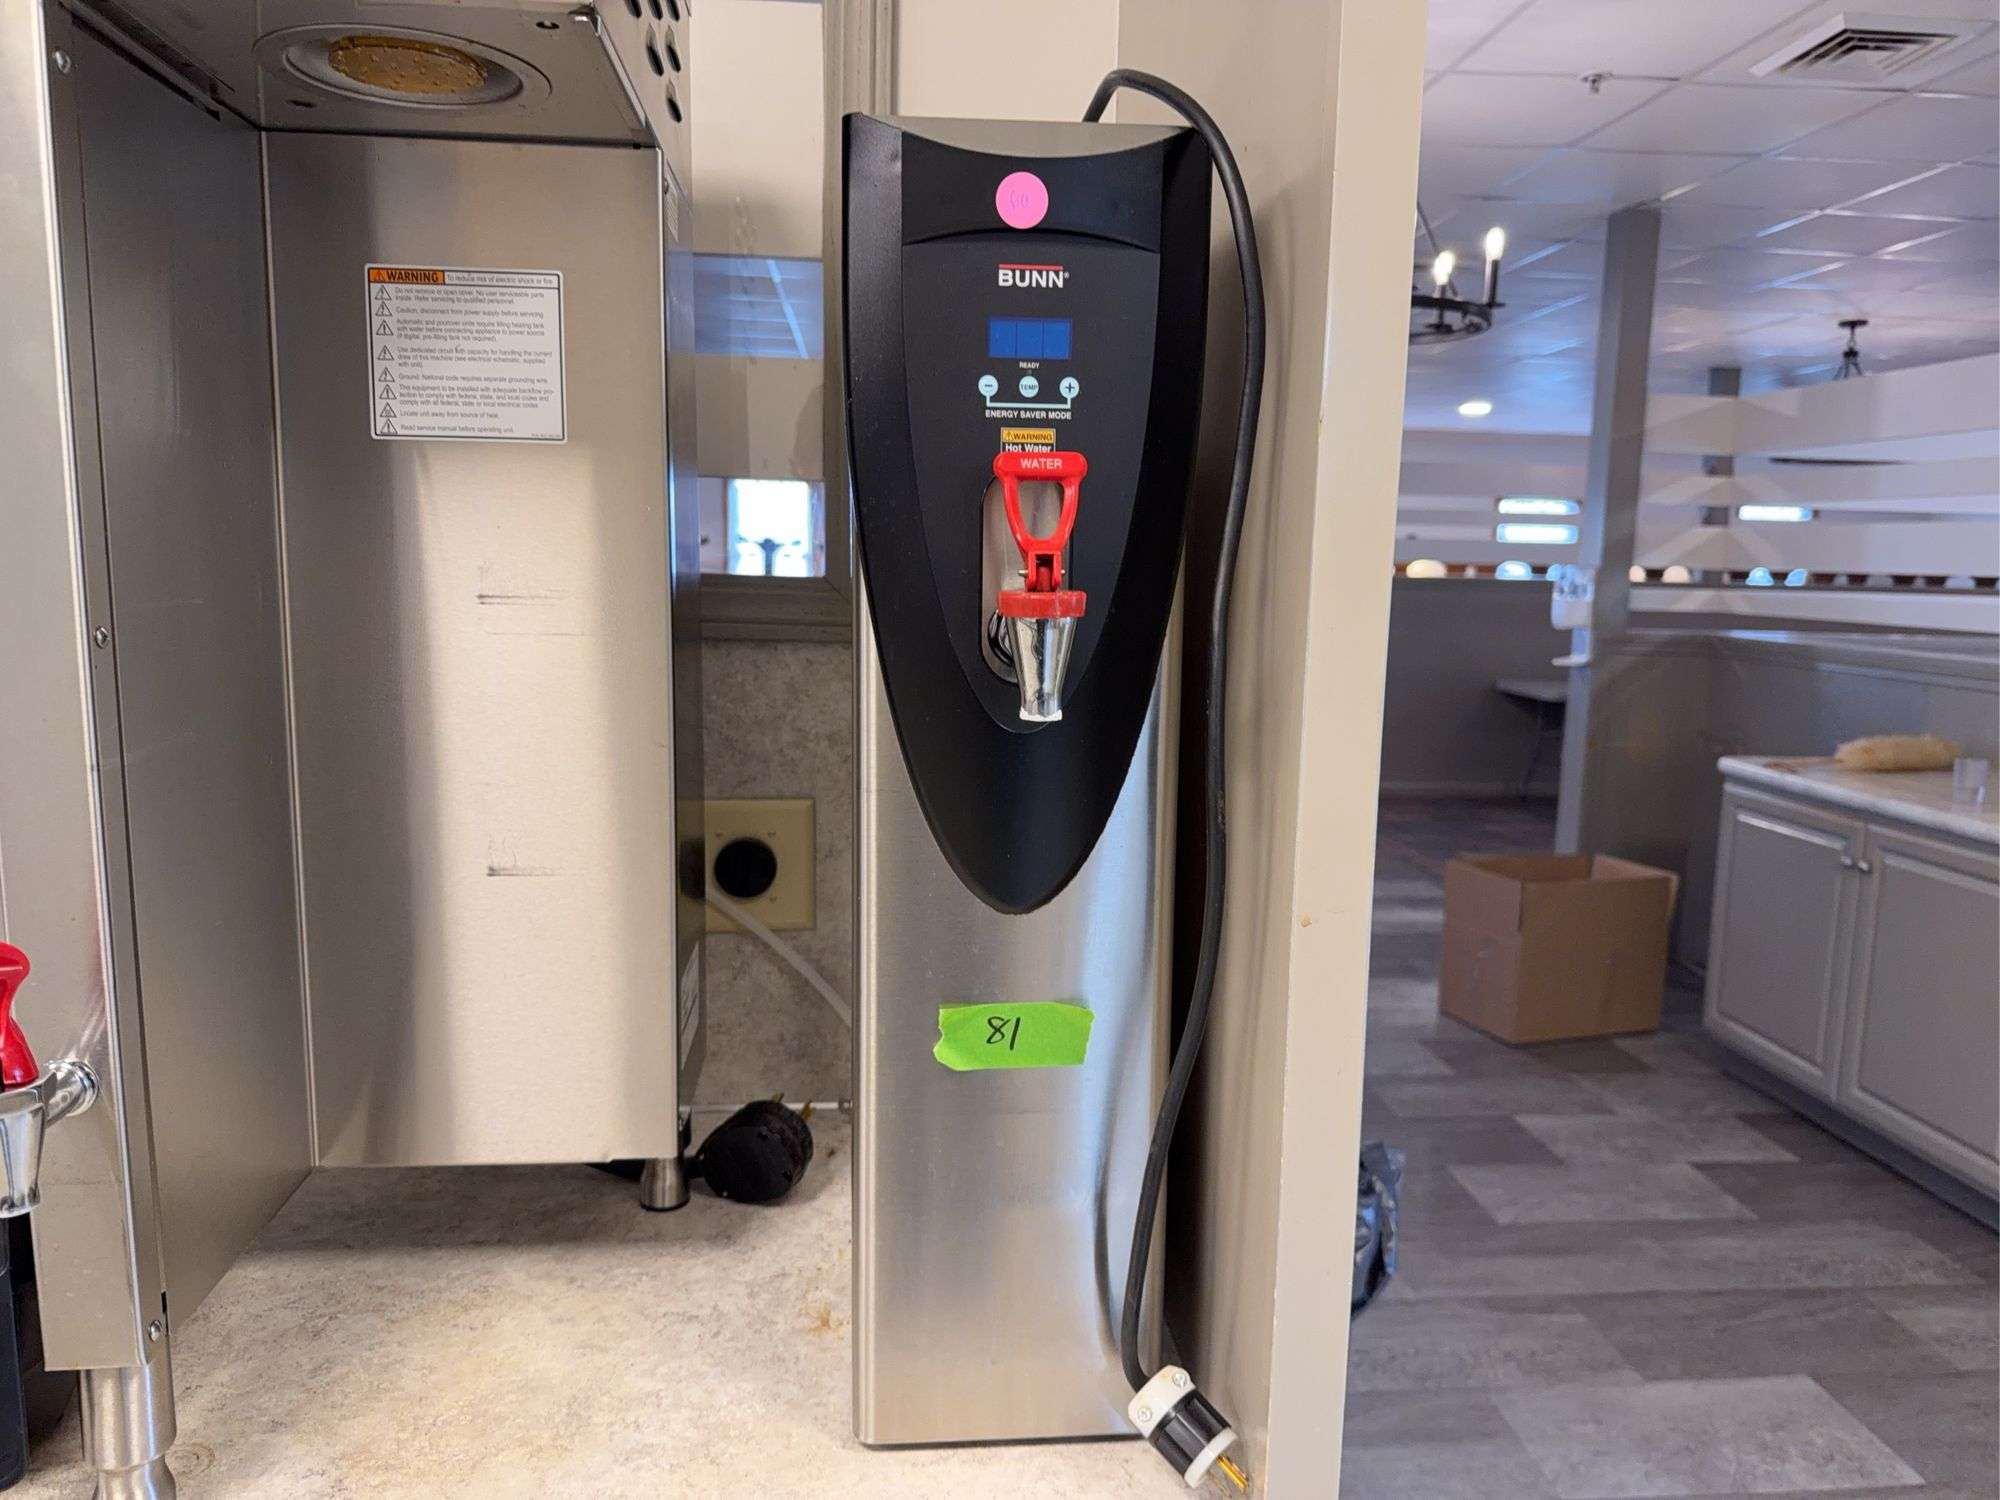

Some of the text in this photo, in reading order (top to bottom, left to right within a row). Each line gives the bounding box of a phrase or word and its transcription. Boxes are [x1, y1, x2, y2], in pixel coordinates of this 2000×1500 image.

[386, 270, 438, 282] WARNING
[1019, 361, 1040, 369] READY
[985, 409, 1072, 420] ENERGY SAVER MODE
[1014, 432, 1053, 441] WARNING
[1005, 443, 1052, 453] Hot Water
[1020, 458, 1062, 470] WATER
[986, 1016, 1021, 1051] 81
